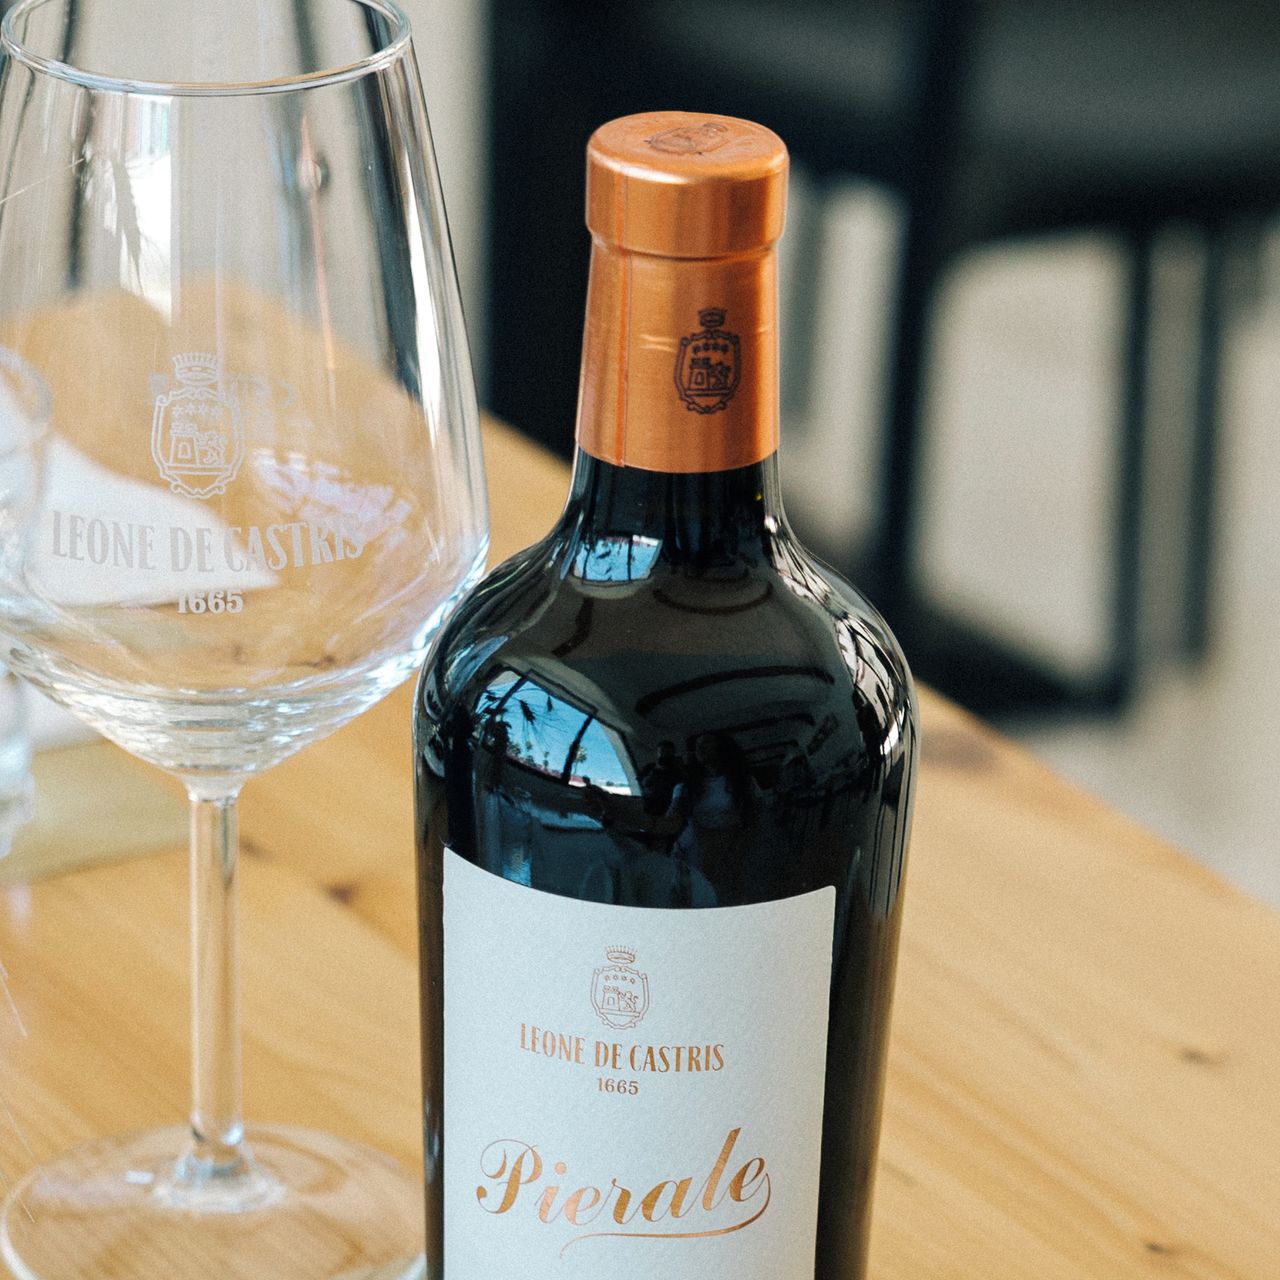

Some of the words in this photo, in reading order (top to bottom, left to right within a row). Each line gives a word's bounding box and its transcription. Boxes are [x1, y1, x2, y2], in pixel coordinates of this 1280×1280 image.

[51, 510, 160, 570] LEONE
[169, 525, 215, 573] DE
[223, 512, 364, 573] CASTRIS
[176, 589, 245, 614] 1665
[519, 1023, 585, 1065] LEONE
[594, 1040, 622, 1070] DE
[629, 1043, 725, 1073] CASTRIS
[597, 1077, 639, 1095] 1665
[475, 1126, 771, 1258] Pierale
